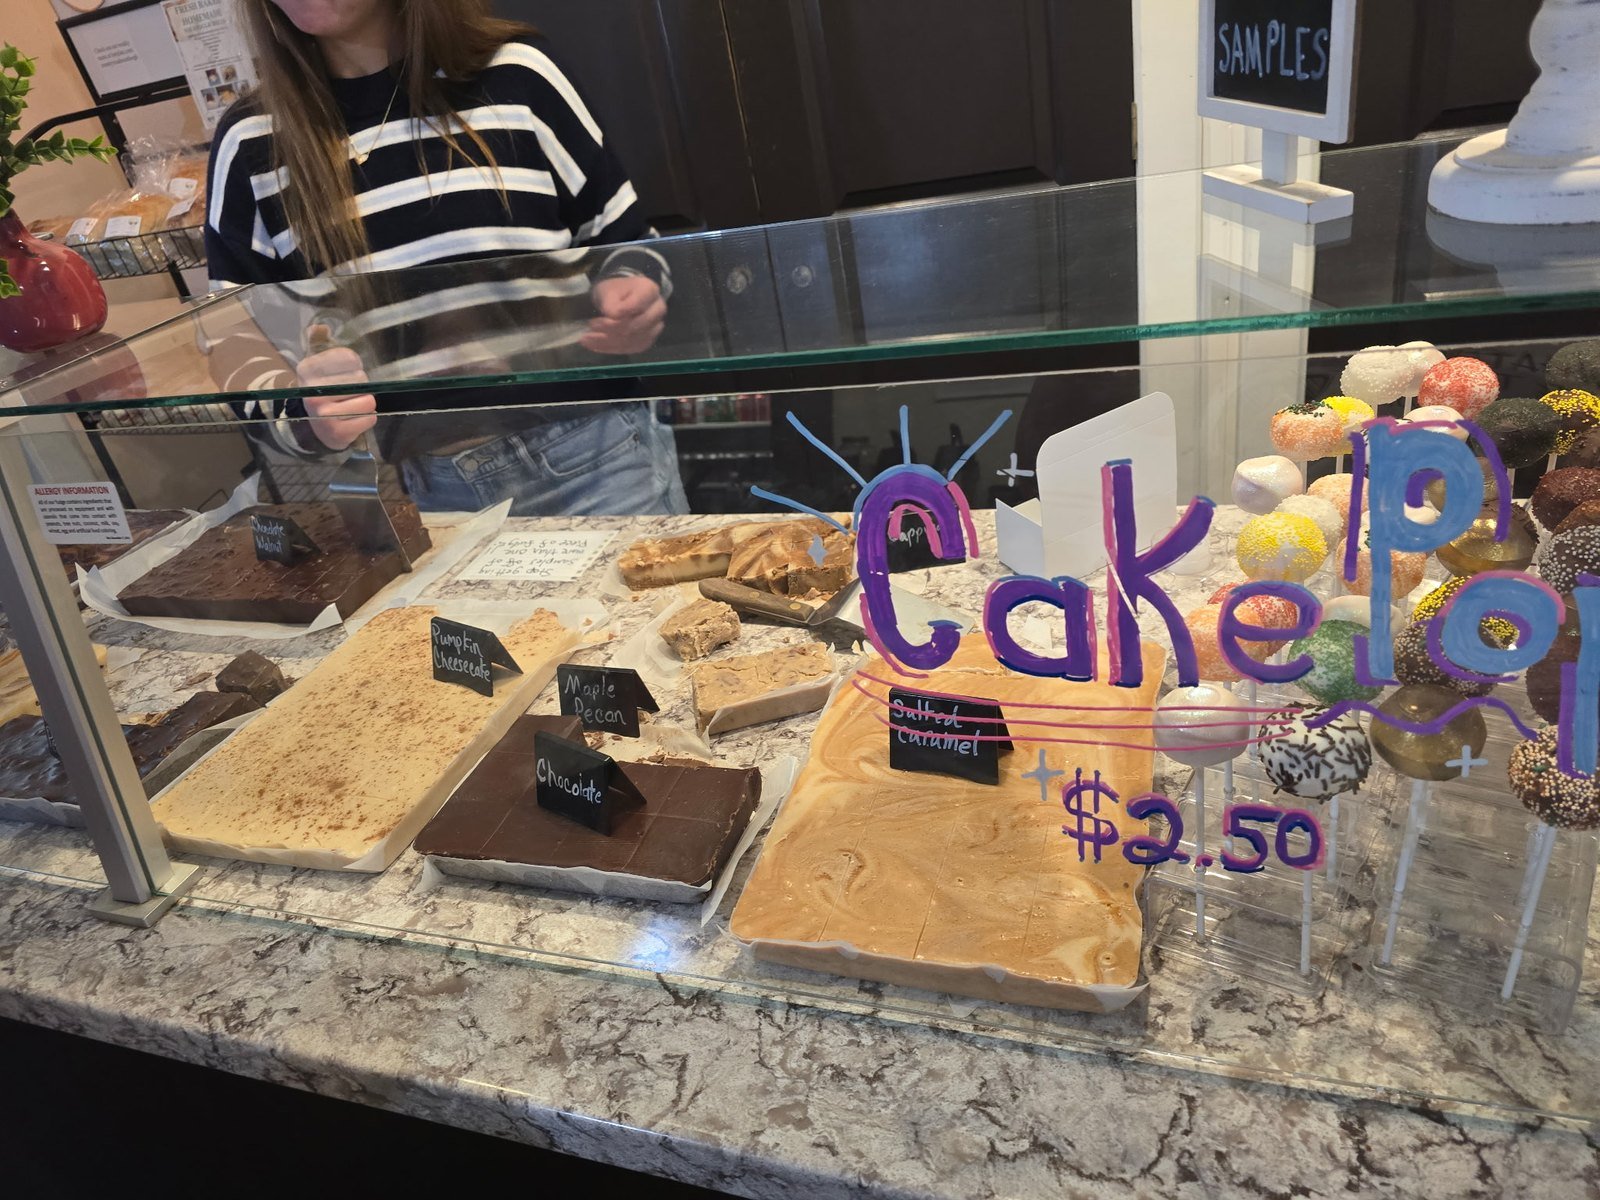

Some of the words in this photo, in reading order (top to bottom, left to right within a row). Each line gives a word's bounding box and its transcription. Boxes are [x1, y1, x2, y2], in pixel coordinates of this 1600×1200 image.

[1218, 19, 1329, 81] SAMPLES
[34, 487, 61, 496] ALLERGY
[62, 486, 110, 495] INFORMATION
[255, 535, 284, 554] Walnut
[853, 459, 1323, 691] Cake
[431, 623, 484, 658] Pumpkin
[433, 645, 491, 682] Cheesecake
[564, 673, 615, 700] Maple
[574, 697, 627, 726] Pecan
[891, 698, 963, 729] Salted
[897, 725, 981, 757] Caramel
[536, 758, 602, 804] Chocolate
[1062, 767, 1325, 872] $2.50
